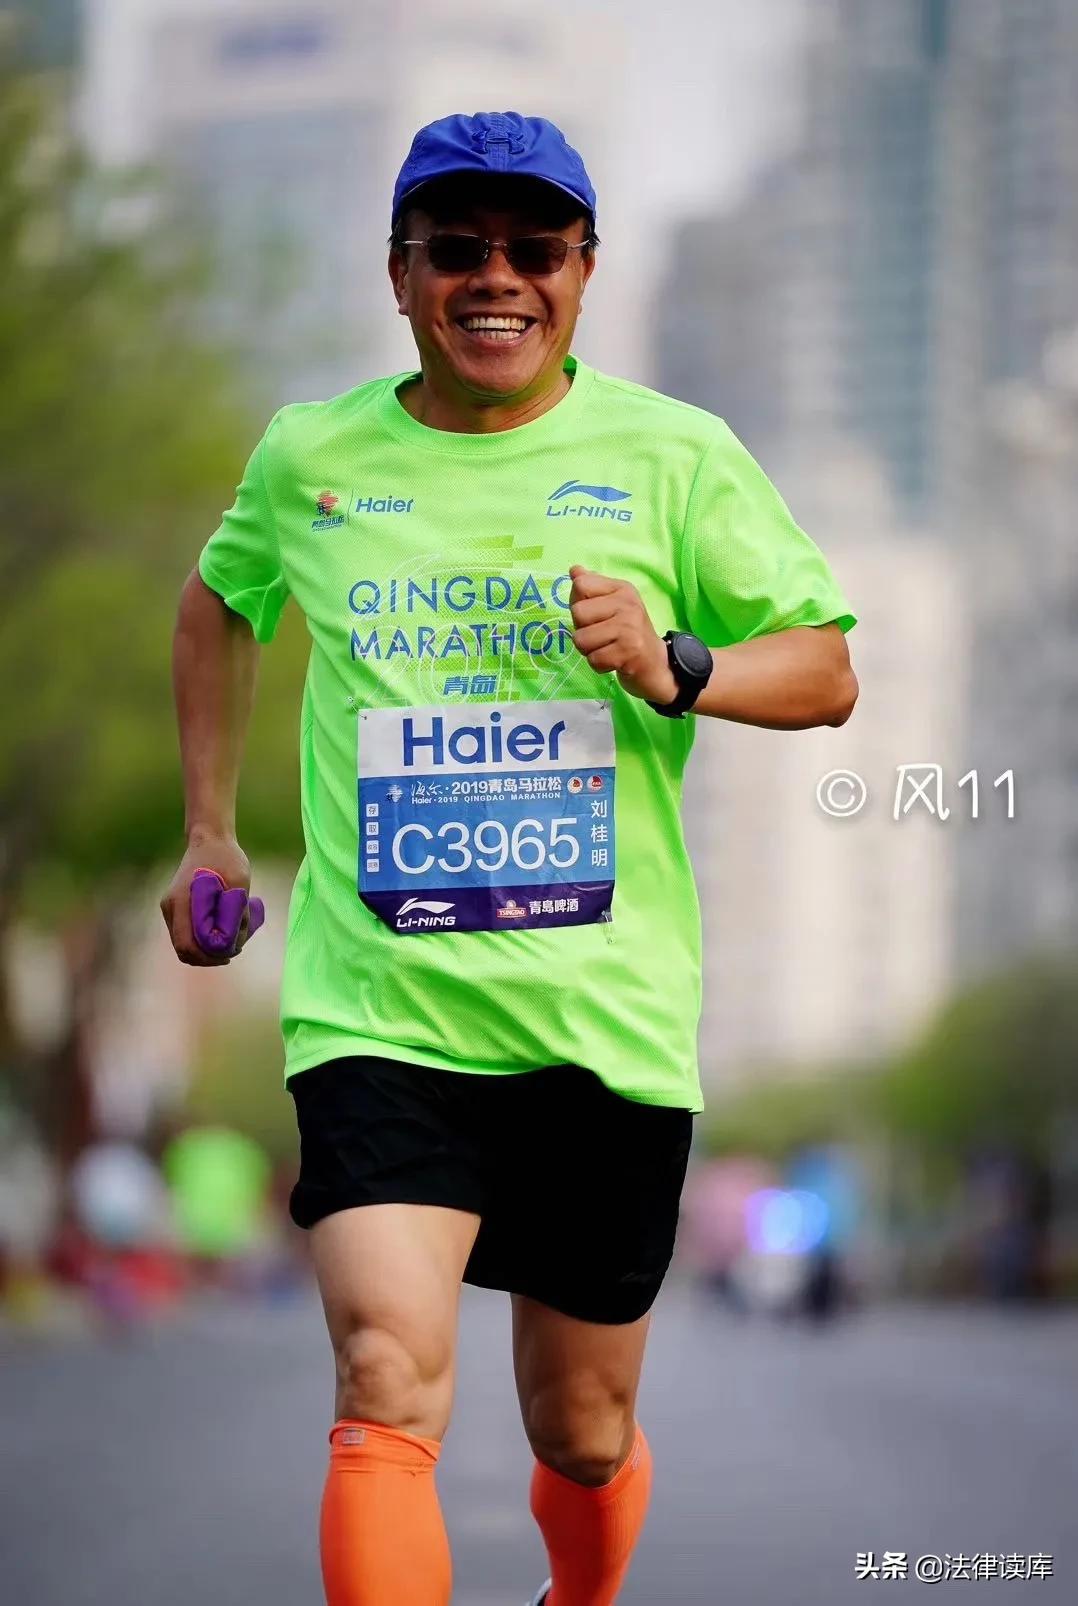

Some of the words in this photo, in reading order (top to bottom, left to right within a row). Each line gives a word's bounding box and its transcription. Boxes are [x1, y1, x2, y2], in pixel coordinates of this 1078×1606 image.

[355, 495, 415, 513] Haier
[546, 505, 632, 522] LI-NING
[402, 711, 566, 767] Haier
[464, 794, 505, 803] QINGDAO
[511, 792, 561, 800] MARATHON
[590, 800, 608, 867] 刘桂明
[392, 817, 580, 874] C3965
[397, 916, 456, 928] LI-NING
